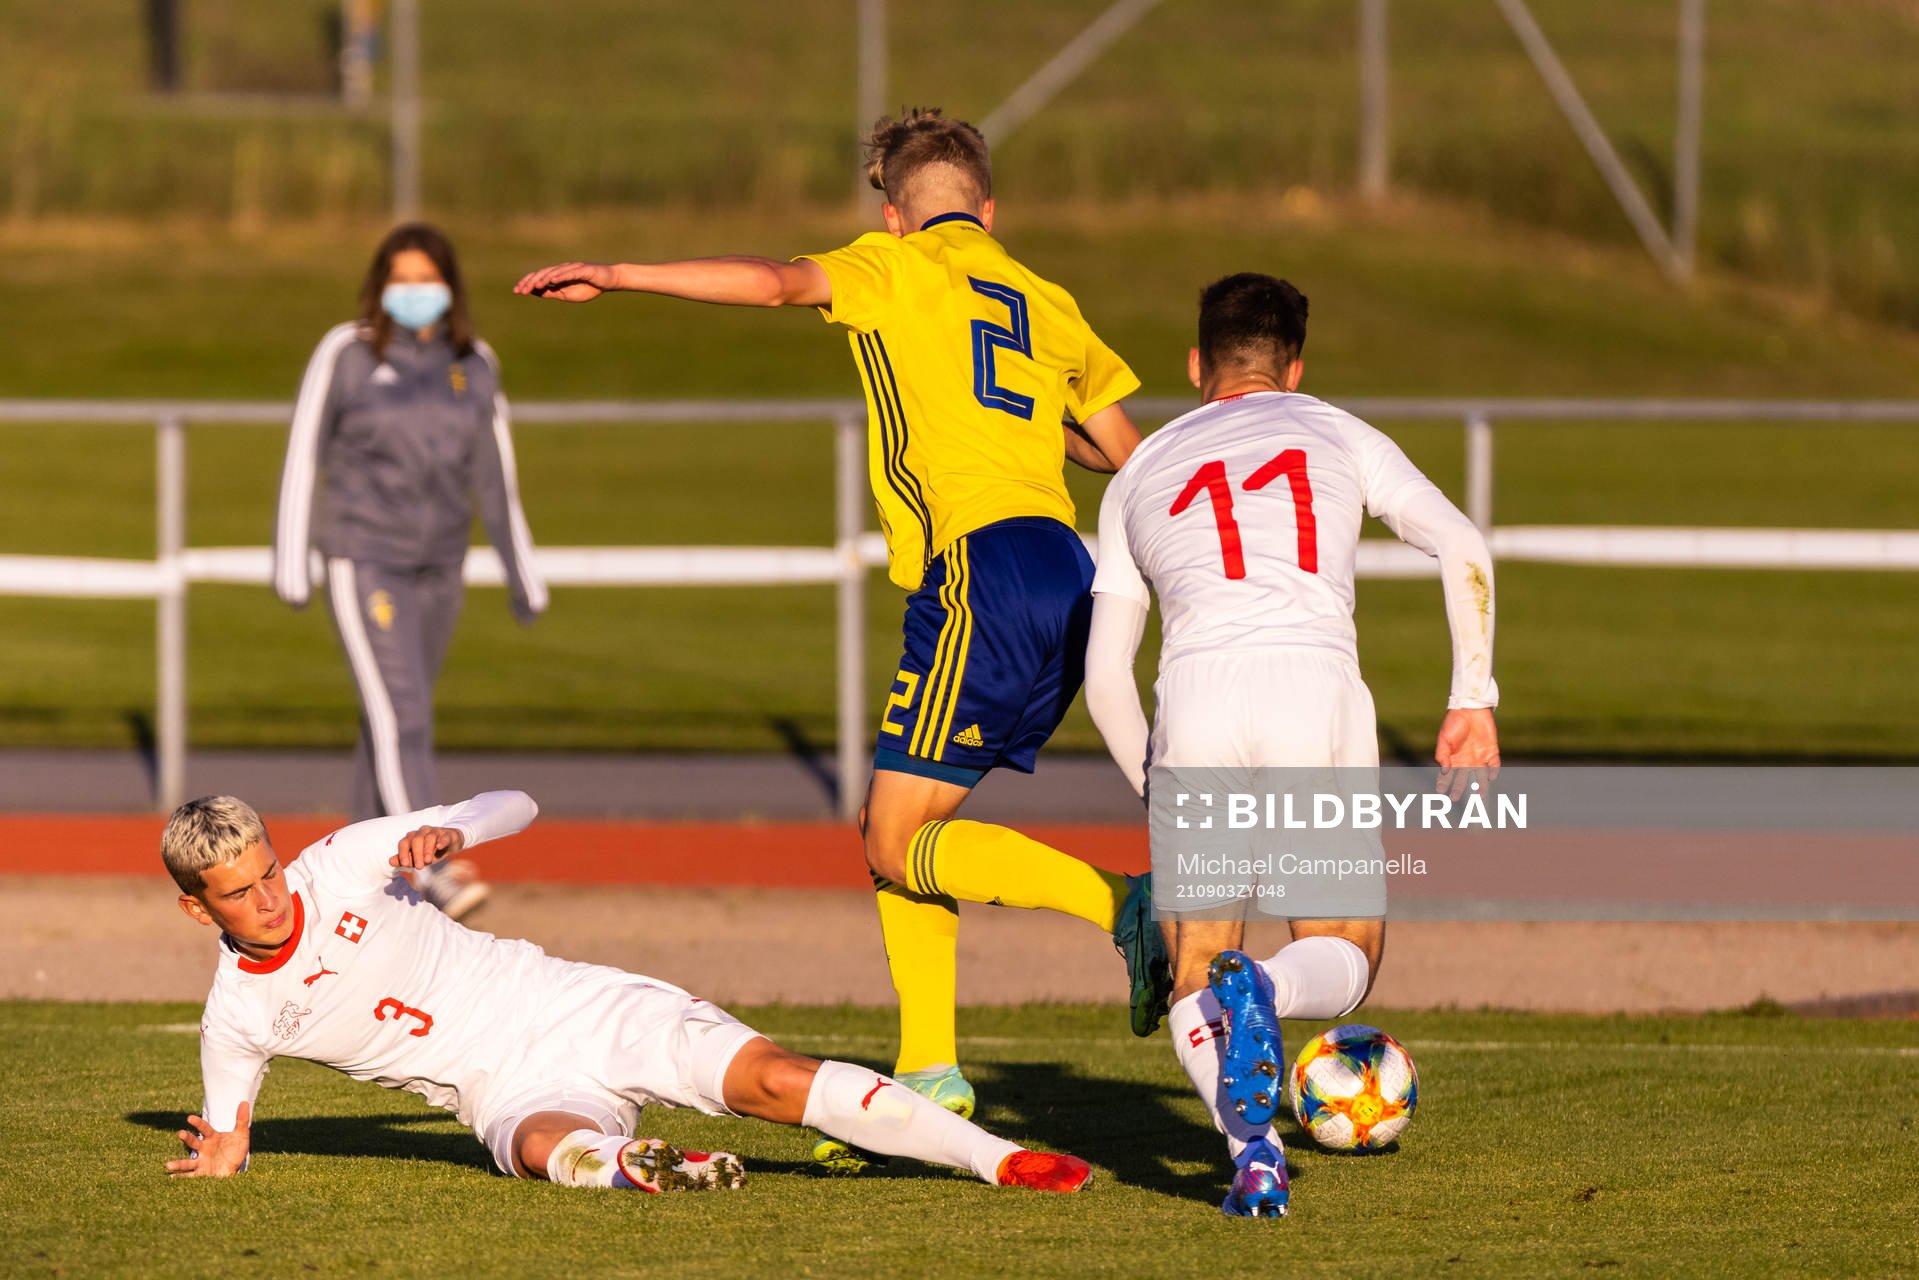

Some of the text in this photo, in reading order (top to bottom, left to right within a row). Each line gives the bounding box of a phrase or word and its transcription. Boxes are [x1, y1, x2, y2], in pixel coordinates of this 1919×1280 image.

[967, 275, 1034, 421] 2
[1169, 449, 1318, 580] 11
[880, 669, 921, 737] 2
[953, 735, 984, 747] adidas
[373, 997, 434, 1038] 3
